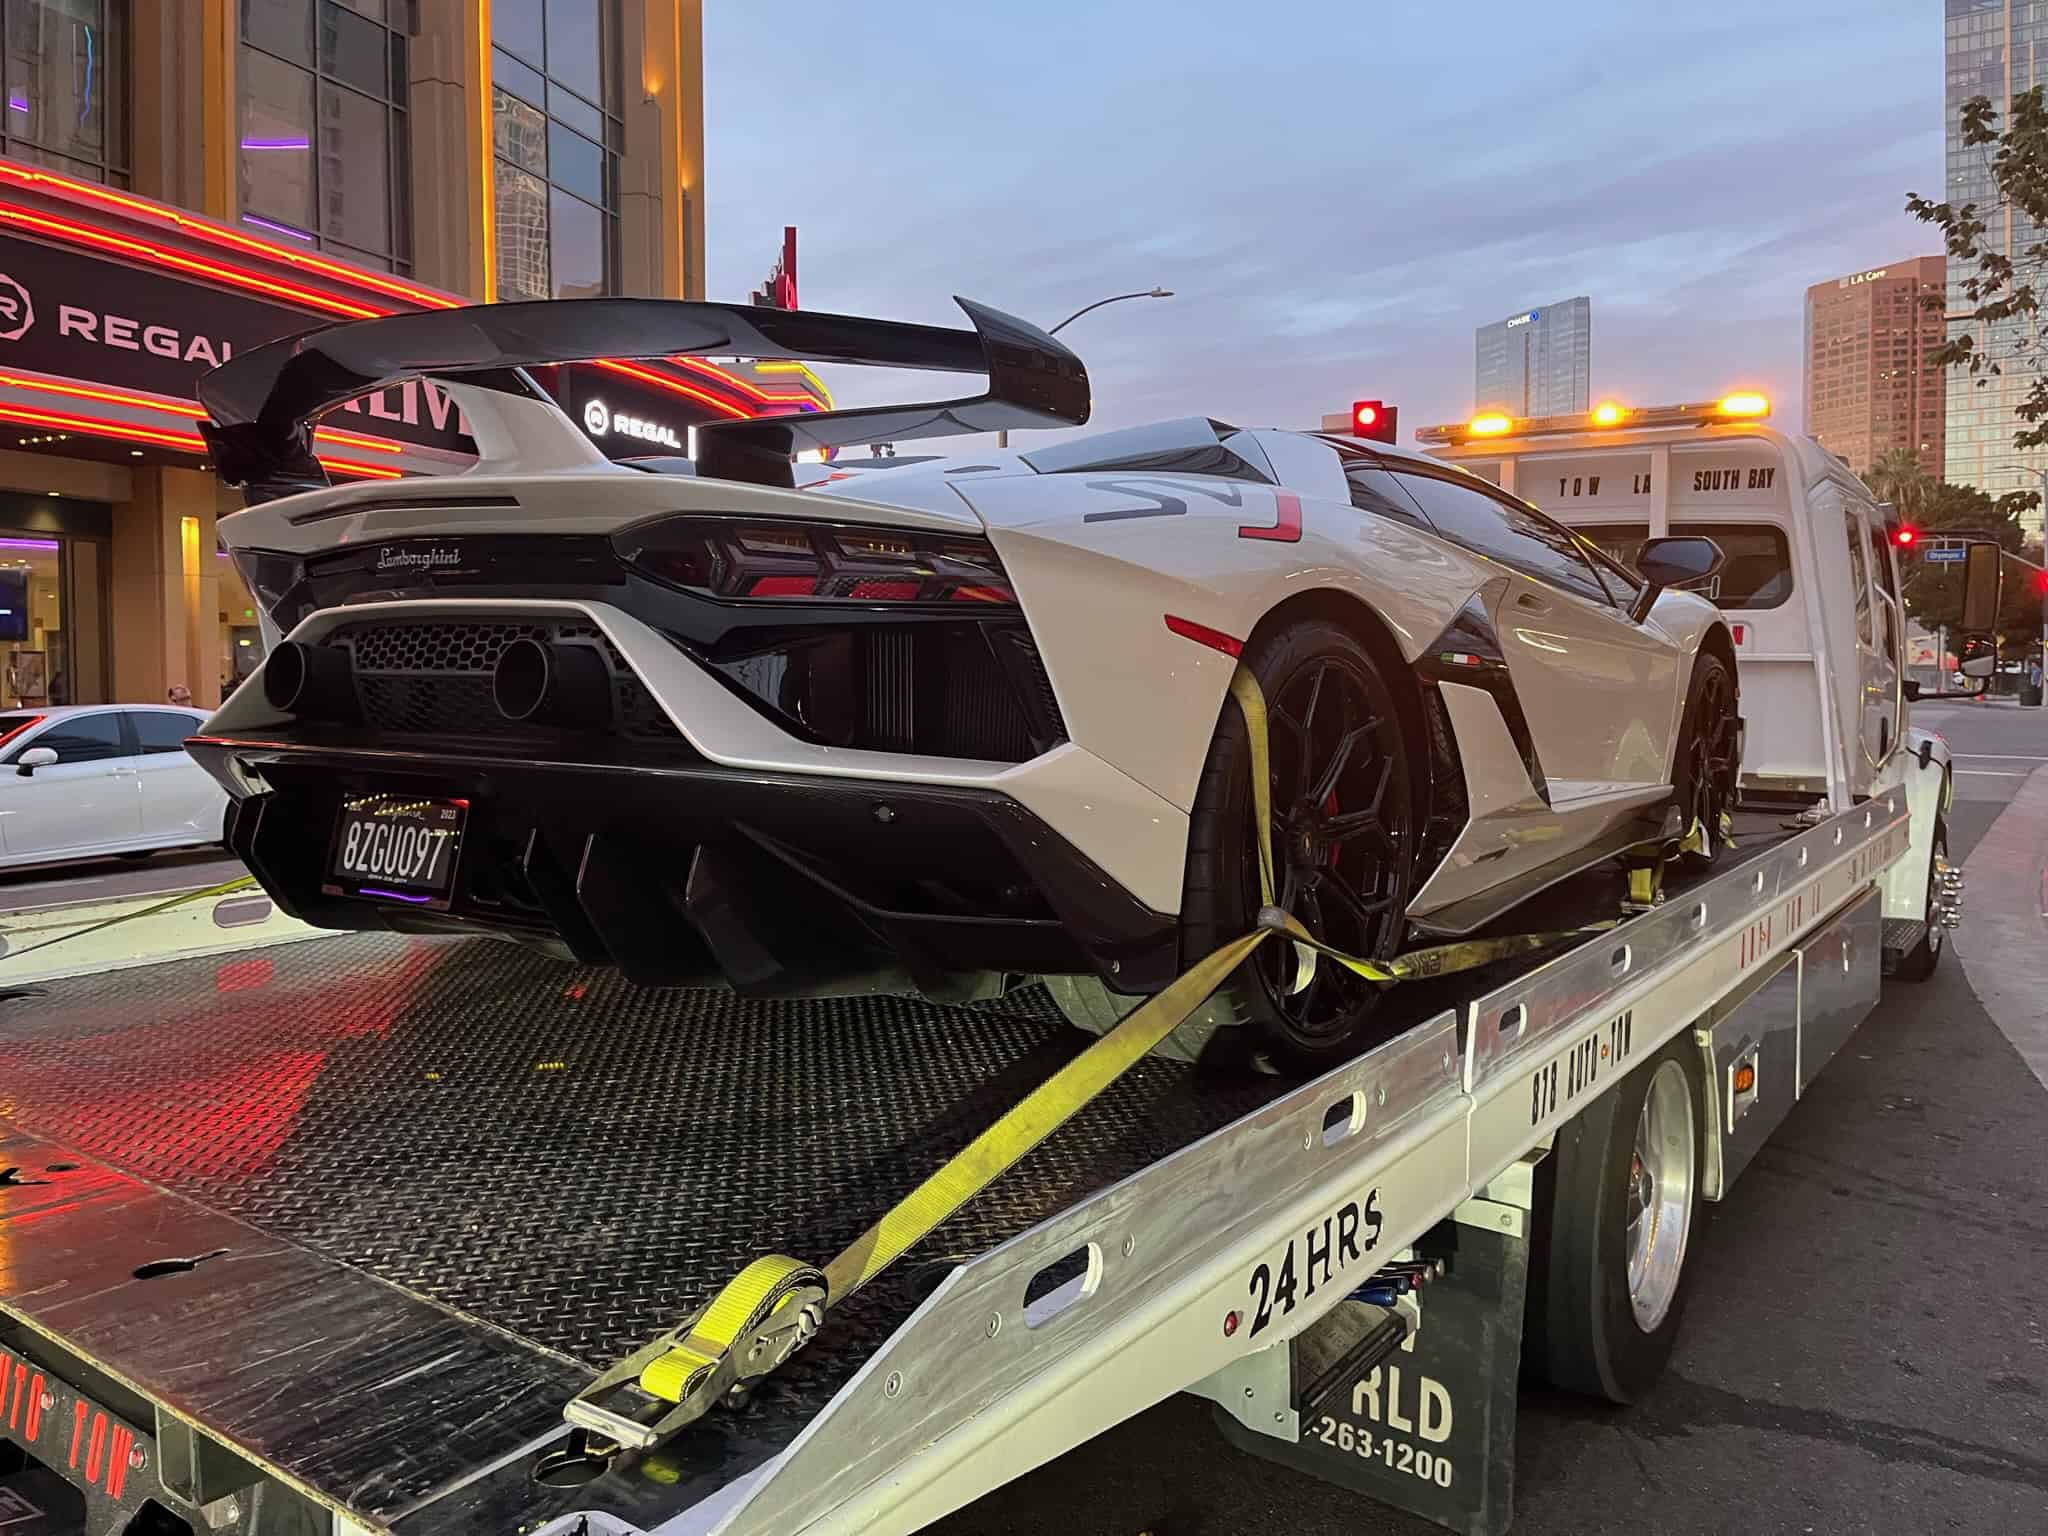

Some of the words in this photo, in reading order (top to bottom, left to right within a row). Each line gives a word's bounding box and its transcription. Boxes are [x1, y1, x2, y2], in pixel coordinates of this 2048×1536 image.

[613, 413, 681, 449] REGAL
[1560, 476, 1600, 497] TOW
[1694, 469, 1740, 491] SOUTH
[1748, 467, 1776, 489] BAY
[377, 547, 462, 569] Lamborghini
[343, 820, 448, 881] 8ZGU097
[1567, 1033, 1598, 1101] AUTO
[1610, 1009, 1632, 1069] TOW
[1249, 1186, 1383, 1339] 24HRS
[69, 1400, 133, 1500] TOW
